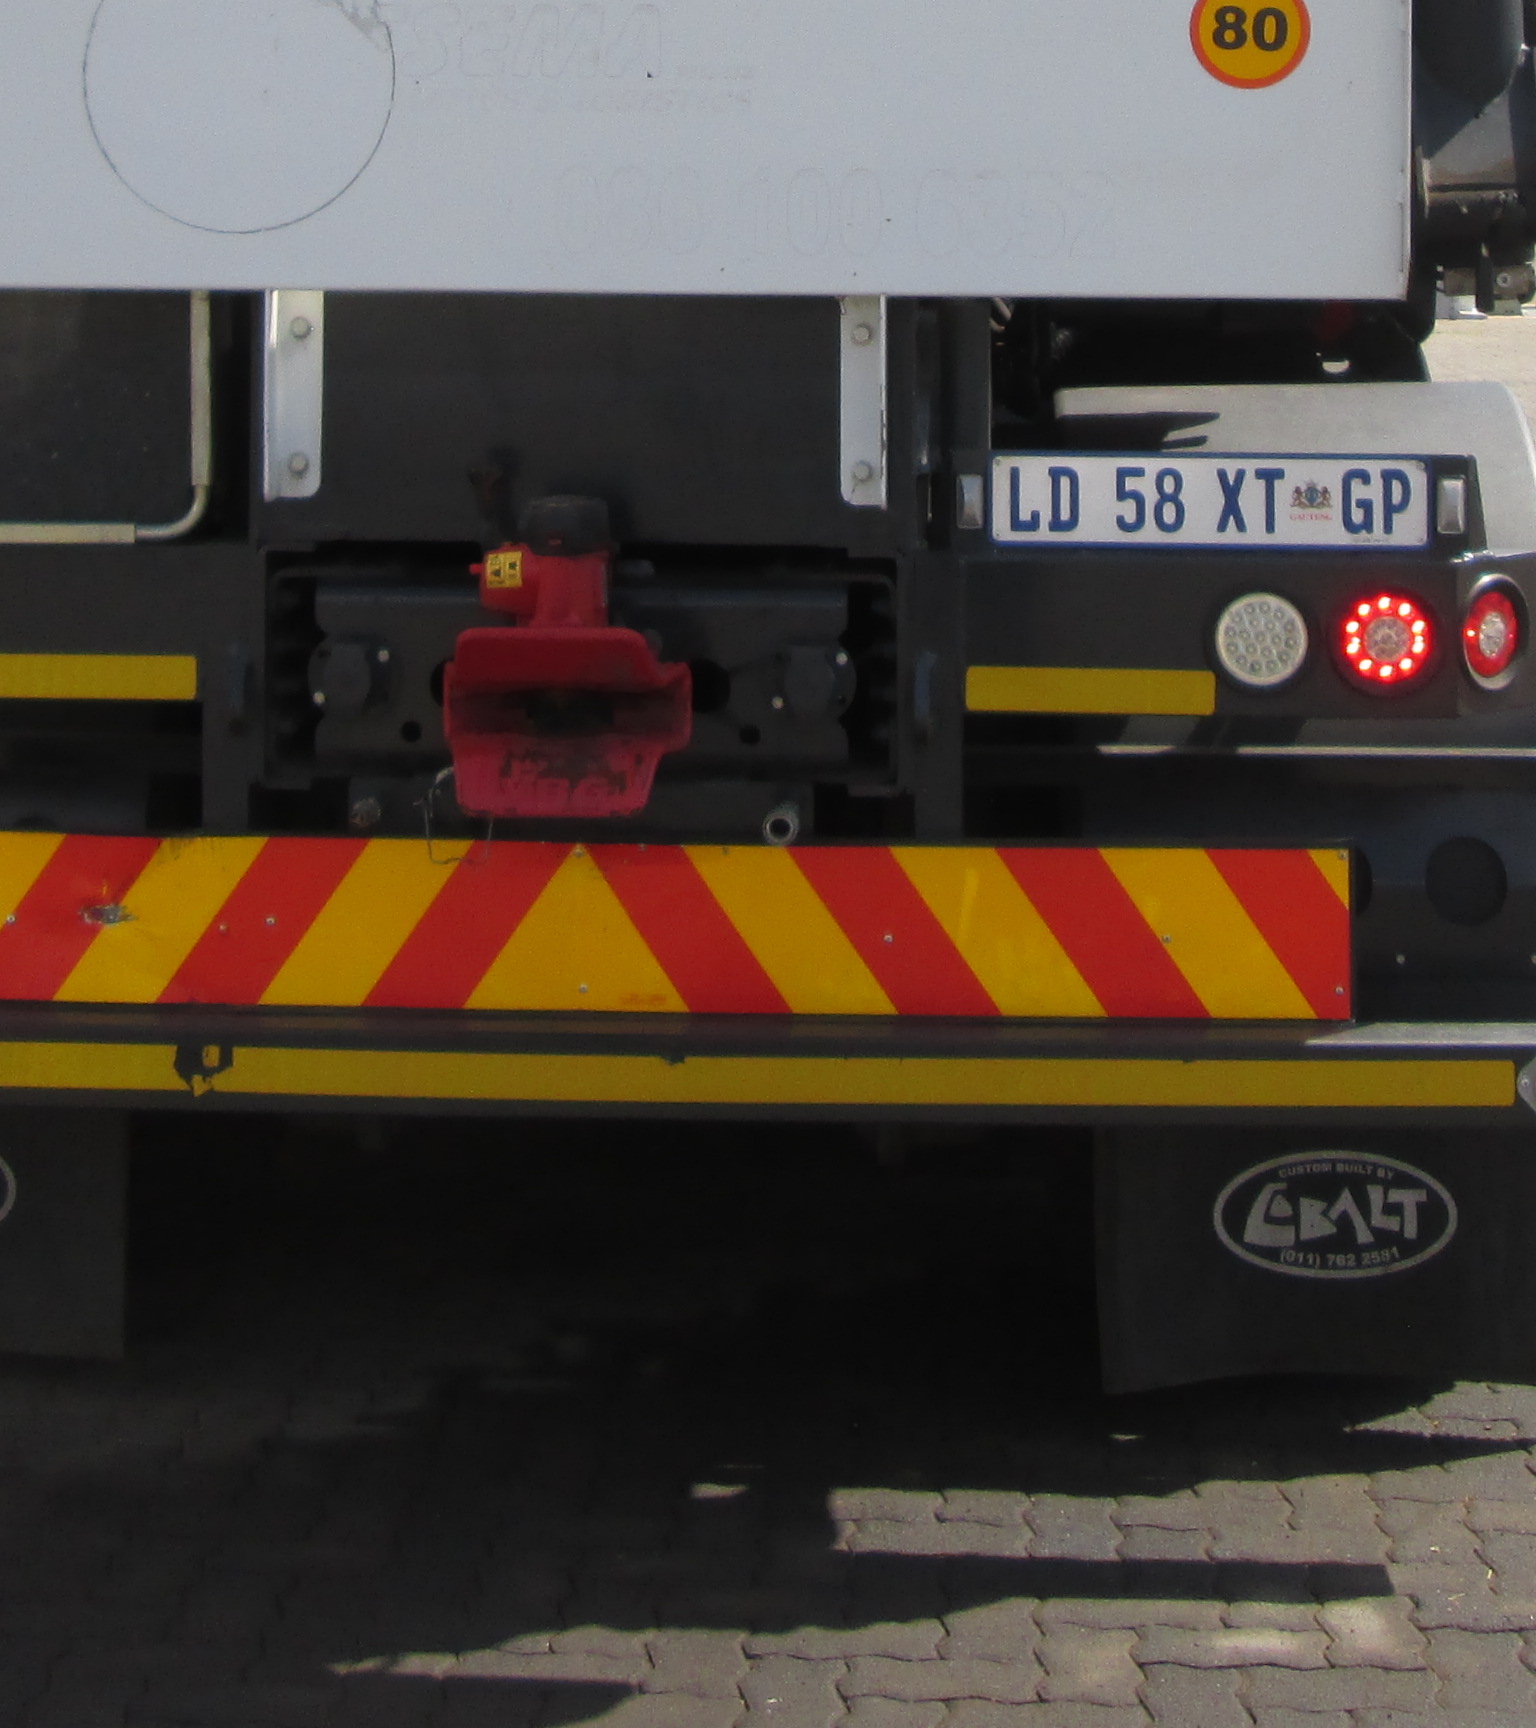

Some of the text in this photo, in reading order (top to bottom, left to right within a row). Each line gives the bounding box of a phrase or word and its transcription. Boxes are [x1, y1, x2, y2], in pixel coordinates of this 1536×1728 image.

[1212, 5, 1289, 52] 80
[1010, 467, 1411, 535] LD 58 XT GP
[1278, 1163, 1395, 1180] CUSTOM BUILT BY
[1279, 1248, 1321, 1269] (011)
[1327, 1253, 1356, 1268] 762
